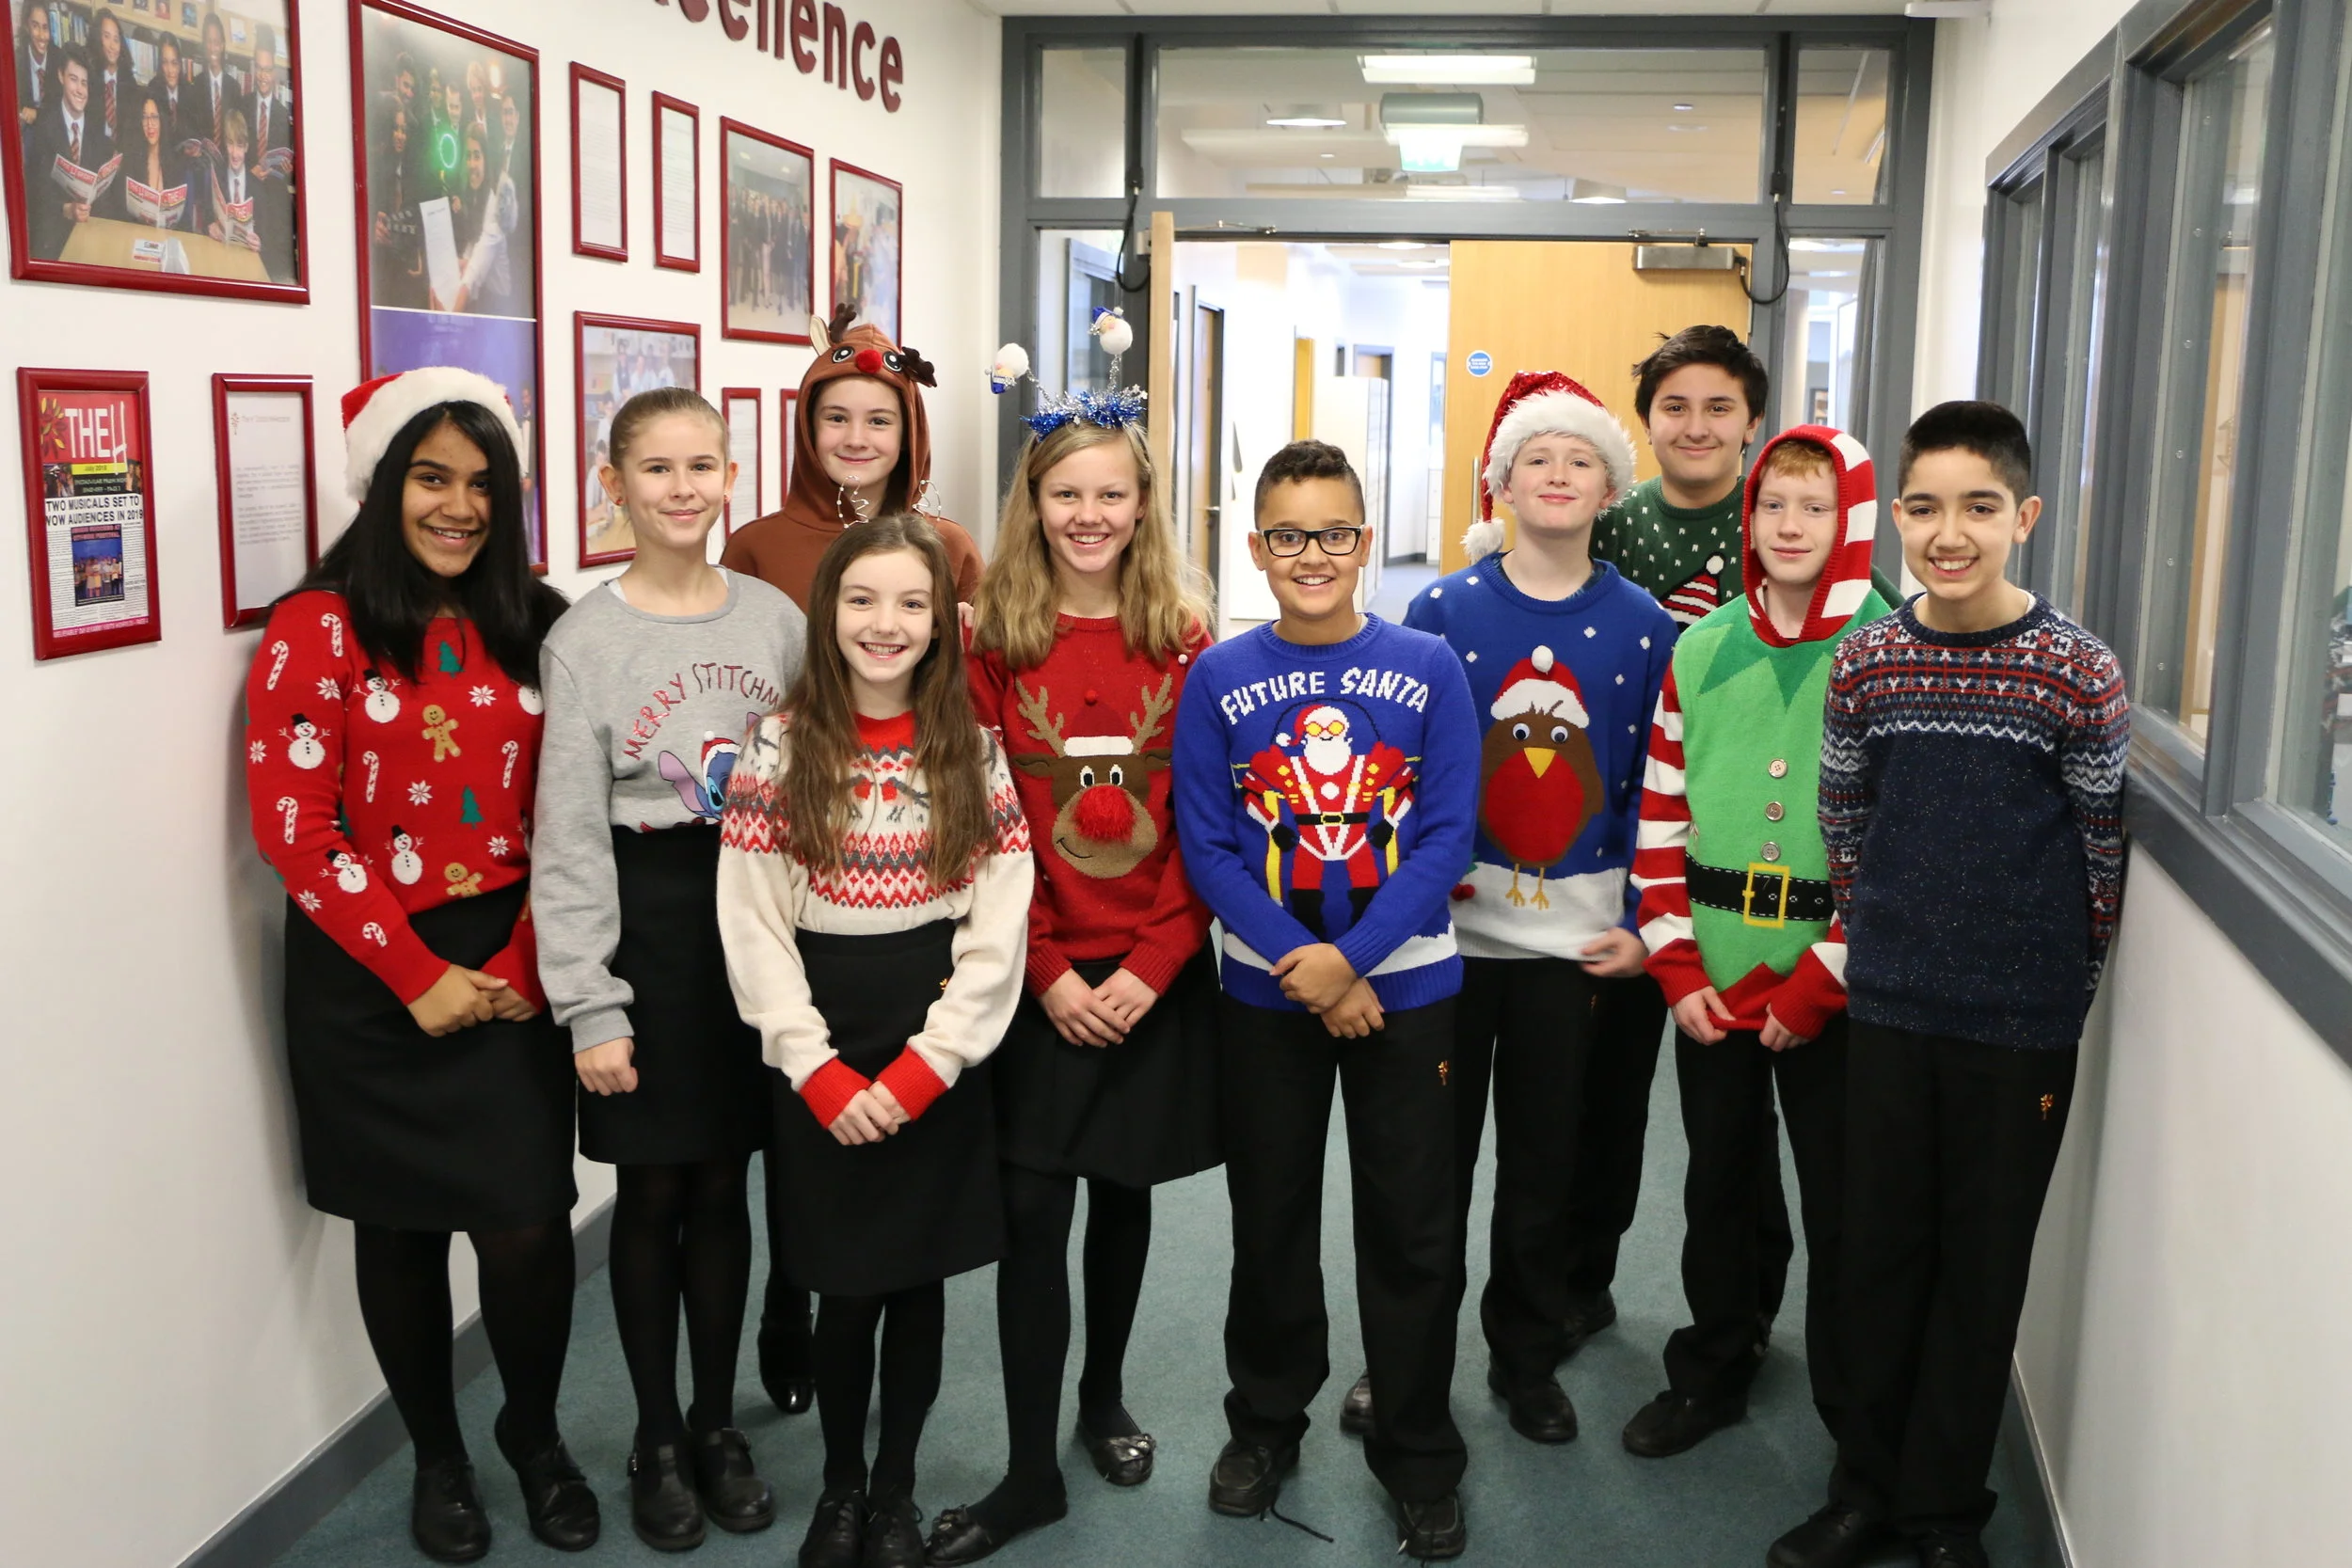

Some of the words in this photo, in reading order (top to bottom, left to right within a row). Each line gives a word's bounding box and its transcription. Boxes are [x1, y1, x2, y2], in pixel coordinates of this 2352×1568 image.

[46, 499, 66, 512] TWO
[69, 497, 110, 510] MUSICALS
[113, 495, 127, 508] SET
[129, 495, 140, 506] TO
[69, 511, 115, 525] AUDIENCES
[118, 509, 125, 521] IN
[127, 509, 143, 520] 2019
[623, 673, 687, 761] MERRY
[692, 662, 780, 712] STITCHM
[1220, 671, 1326, 725] FUTURE
[1340, 666, 1429, 713] SANTA
